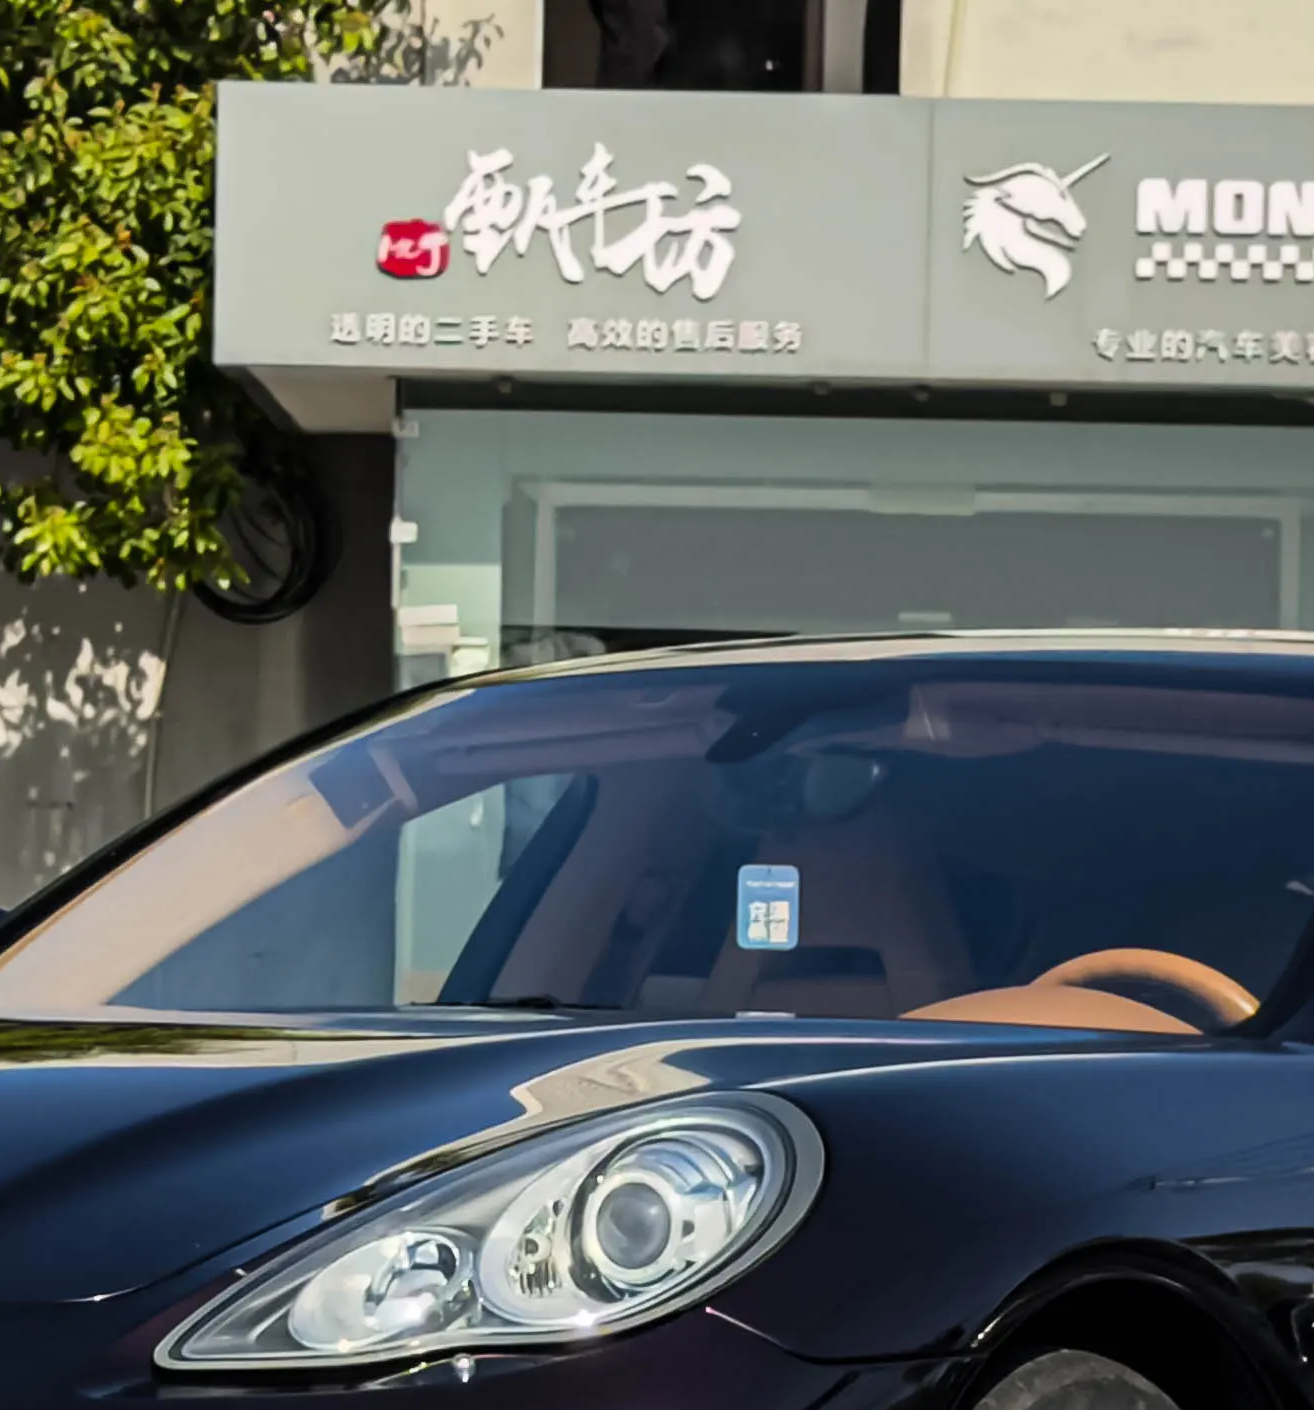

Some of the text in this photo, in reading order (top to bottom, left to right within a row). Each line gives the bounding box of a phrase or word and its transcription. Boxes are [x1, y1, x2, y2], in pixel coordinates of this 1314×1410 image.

[331, 312, 803, 353] 透明的二手车 高效的售后服务
